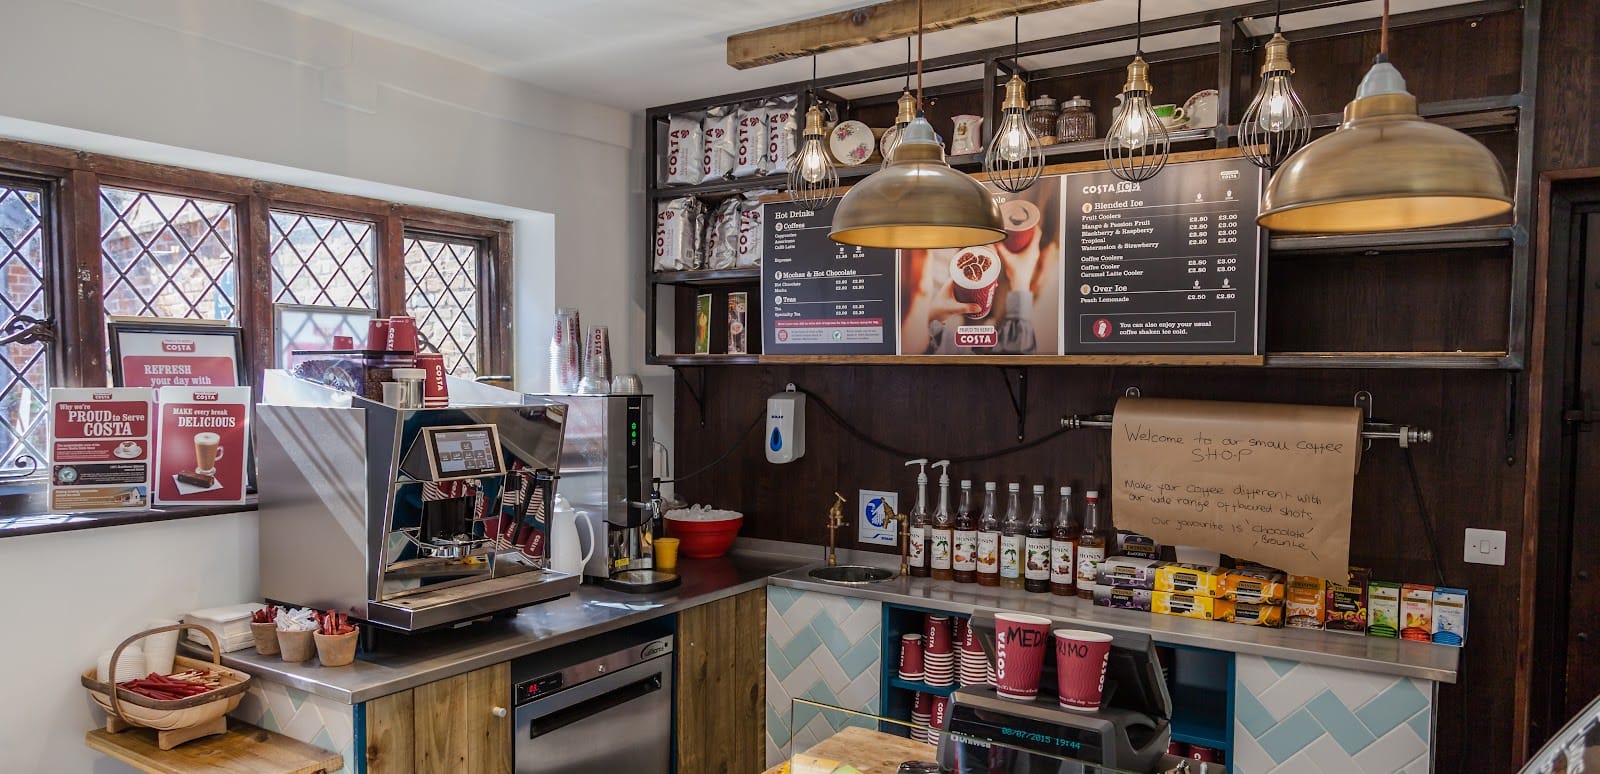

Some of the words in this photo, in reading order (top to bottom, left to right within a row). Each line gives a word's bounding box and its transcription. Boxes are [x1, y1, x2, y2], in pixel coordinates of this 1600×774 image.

[738, 116, 749, 166] COSTA
[769, 113, 780, 164] COSTA
[669, 129, 680, 176] COSTA
[703, 127, 714, 176] COSTA
[1082, 183, 1115, 195] COSTA
[1094, 201, 1128, 211] Blended
[1130, 199, 1144, 208] Ice
[775, 211, 789, 220] Hot
[790, 209, 816, 219] Drinks
[739, 208, 750, 255] COSTA
[783, 222, 805, 230] Coffees
[1081, 223, 1102, 232] Mango
[1110, 221, 1133, 229] Passion
[1134, 219, 1151, 227] Fruit
[657, 211, 666, 257] COSTA
[1081, 230, 1115, 239] Blackberry
[1122, 227, 1154, 236] Raspberry
[1081, 237, 1106, 246] Tropical
[1081, 245, 1116, 253] Watermelon
[1123, 242, 1159, 251] Strawberry
[1080, 255, 1099, 263] Coffee
[1100, 254, 1124, 262] Coolers
[1080, 263, 1099, 271] Coffee
[1100, 262, 1120, 270] Cooler
[782, 271, 806, 279] Mochas
[813, 269, 825, 277] Hot
[825, 268, 857, 277] Chocolate
[1080, 270, 1105, 279] Caramel
[1106, 269, 1122, 277] Latte
[1092, 285, 1113, 293] Over
[1115, 284, 1128, 292] Ice
[1099, 295, 1130, 303] Lemonade
[1119, 321, 1131, 329] You
[1158, 321, 1176, 329] enjoy
[1177, 321, 1192, 329] your
[1193, 319, 1212, 327] usual
[1119, 328, 1137, 336] coffee
[1138, 328, 1160, 336] shaken
[1161, 327, 1172, 335] ice
[594, 328, 602, 356] COSTA
[960, 334, 992, 345] COSTA
[166, 344, 192, 352] COSTA
[144, 364, 192, 375] REFRESH
[150, 377, 171, 388] your
[172, 376, 189, 387] day
[191, 375, 212, 386] with
[435, 364, 444, 392] COSTA
[59, 403, 73, 412] Why
[172, 407, 192, 415] MAKE
[193, 409, 210, 418] every
[211, 407, 228, 416] break
[68, 410, 111, 422] PROUD
[112, 414, 120, 422] to
[121, 413, 145, 421] Serve
[178, 415, 236, 428] DELICIOUS
[83, 422, 133, 436] COSTA
[1124, 423, 1185, 444] Welcome
[1193, 431, 1212, 445] to
[1222, 438, 1243, 446] our
[1248, 438, 1291, 451] small
[1124, 480, 1153, 492] Make
[1233, 484, 1293, 500] different
[1297, 494, 1322, 505] with
[1150, 495, 1172, 505] wide
[1176, 497, 1210, 512] range
[1216, 500, 1231, 513] of
[1151, 516, 1170, 526] Our
[1176, 518, 1225, 533] favourite
[996, 631, 1006, 680] COSTA
[1097, 651, 1110, 693] COSTA
[936, 702, 944, 724] COSTA
[1001, 726, 1051, 744] 08/07/2015
[1055, 737, 1081, 750] 19:44
